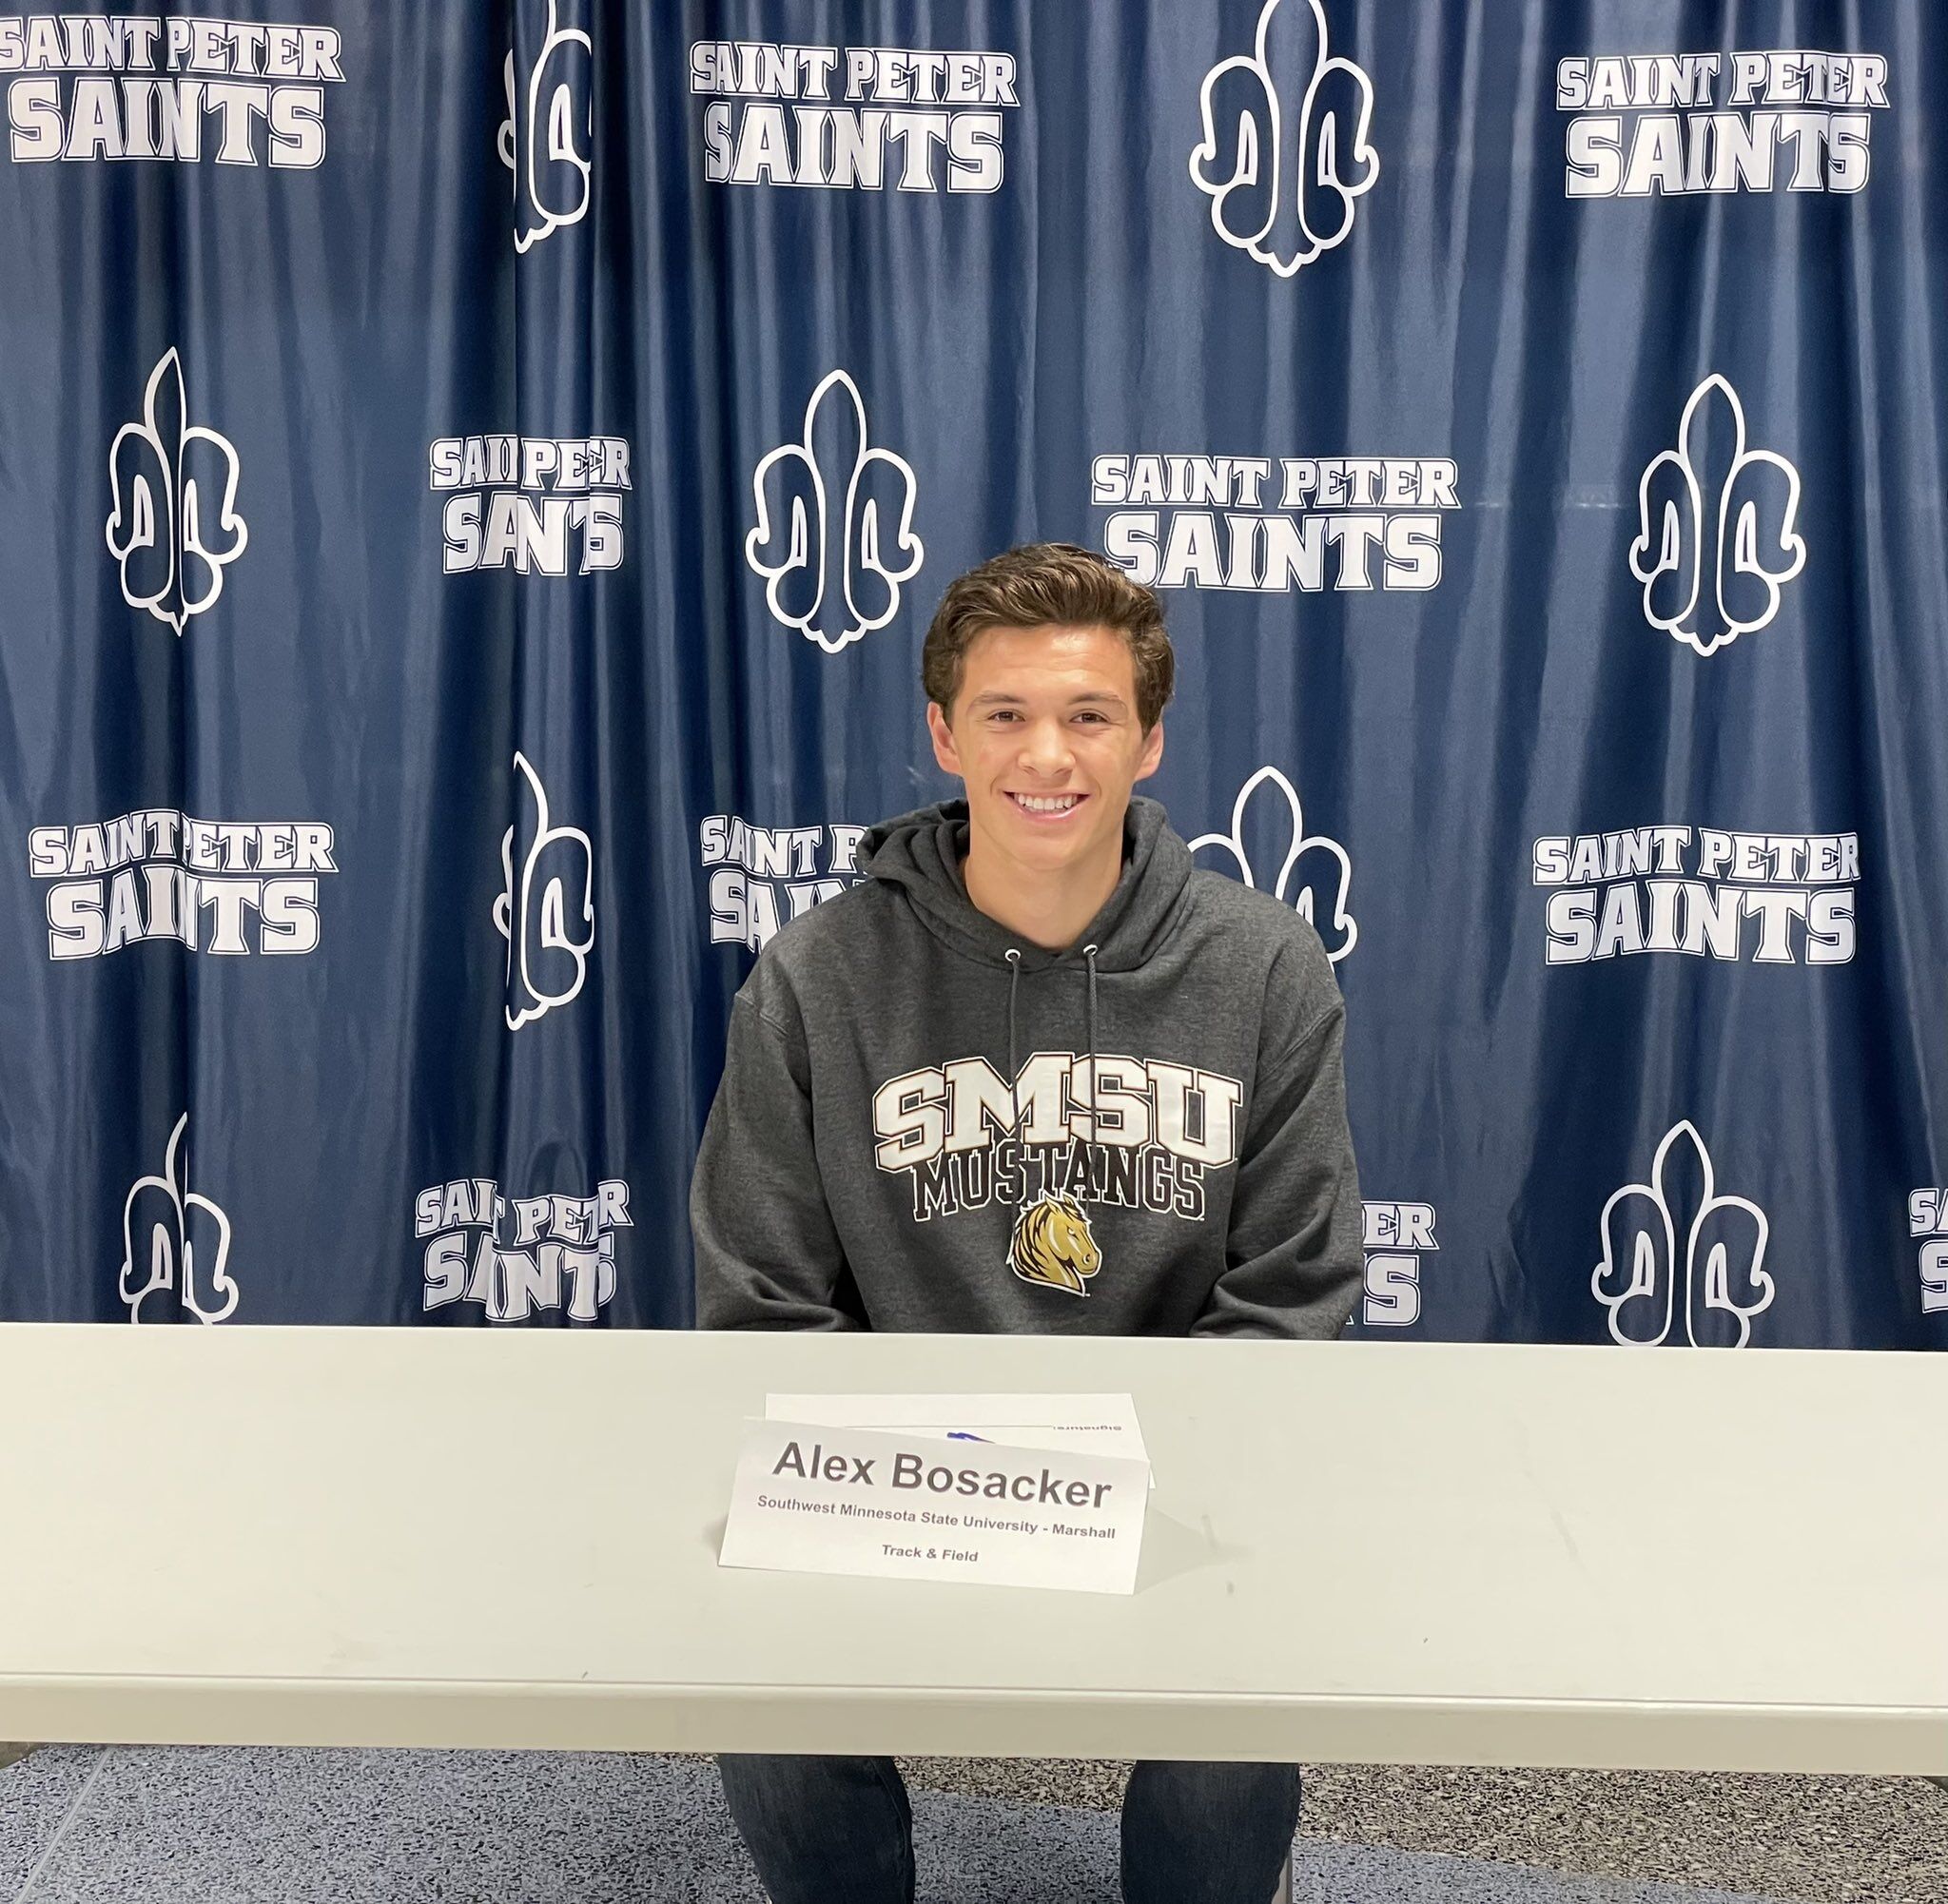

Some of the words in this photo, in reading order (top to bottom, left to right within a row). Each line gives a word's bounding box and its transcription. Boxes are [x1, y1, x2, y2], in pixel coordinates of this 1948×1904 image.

[0, 15, 161, 72] SAINT
[166, 17, 347, 83] PETER
[691, 41, 837, 101] SAINT
[845, 48, 1021, 107] PETER
[1556, 52, 1720, 110] SAINT
[1728, 50, 1890, 108] PETER
[9, 76, 326, 169] SAINTS
[705, 101, 1005, 193] SAINTS
[1566, 110, 1872, 198] SAINTS
[430, 434, 517, 491] SAI
[520, 436, 633, 491] PEER
[1091, 455, 1271, 509] SAINT
[1277, 457, 1462, 509] PETER
[1105, 511, 1442, 593] SAINTS
[29, 808, 179, 877] SAINT
[700, 815, 822, 878] SAINT
[1533, 825, 1690, 884] SAINT
[1699, 827, 1860, 883] PETER
[47, 864, 321, 961] SAINTS
[1546, 880, 1858, 965] SAINTS
[872, 1051, 1243, 1173] SMSU
[911, 1138, 1205, 1222] MUSTANGS
[771, 1441, 876, 1486] Alex
[891, 1452, 1113, 1509] Bosacker
[757, 1495, 836, 1515] Southwest
[840, 1504, 916, 1523] Minnesota
[921, 1512, 959, 1527] State
[963, 1516, 1038, 1535] University
[1052, 1524, 1117, 1540] Marshall
[882, 1545, 922, 1560] Track
[926, 1548, 937, 1560] &
[942, 1549, 979, 1563] Field
